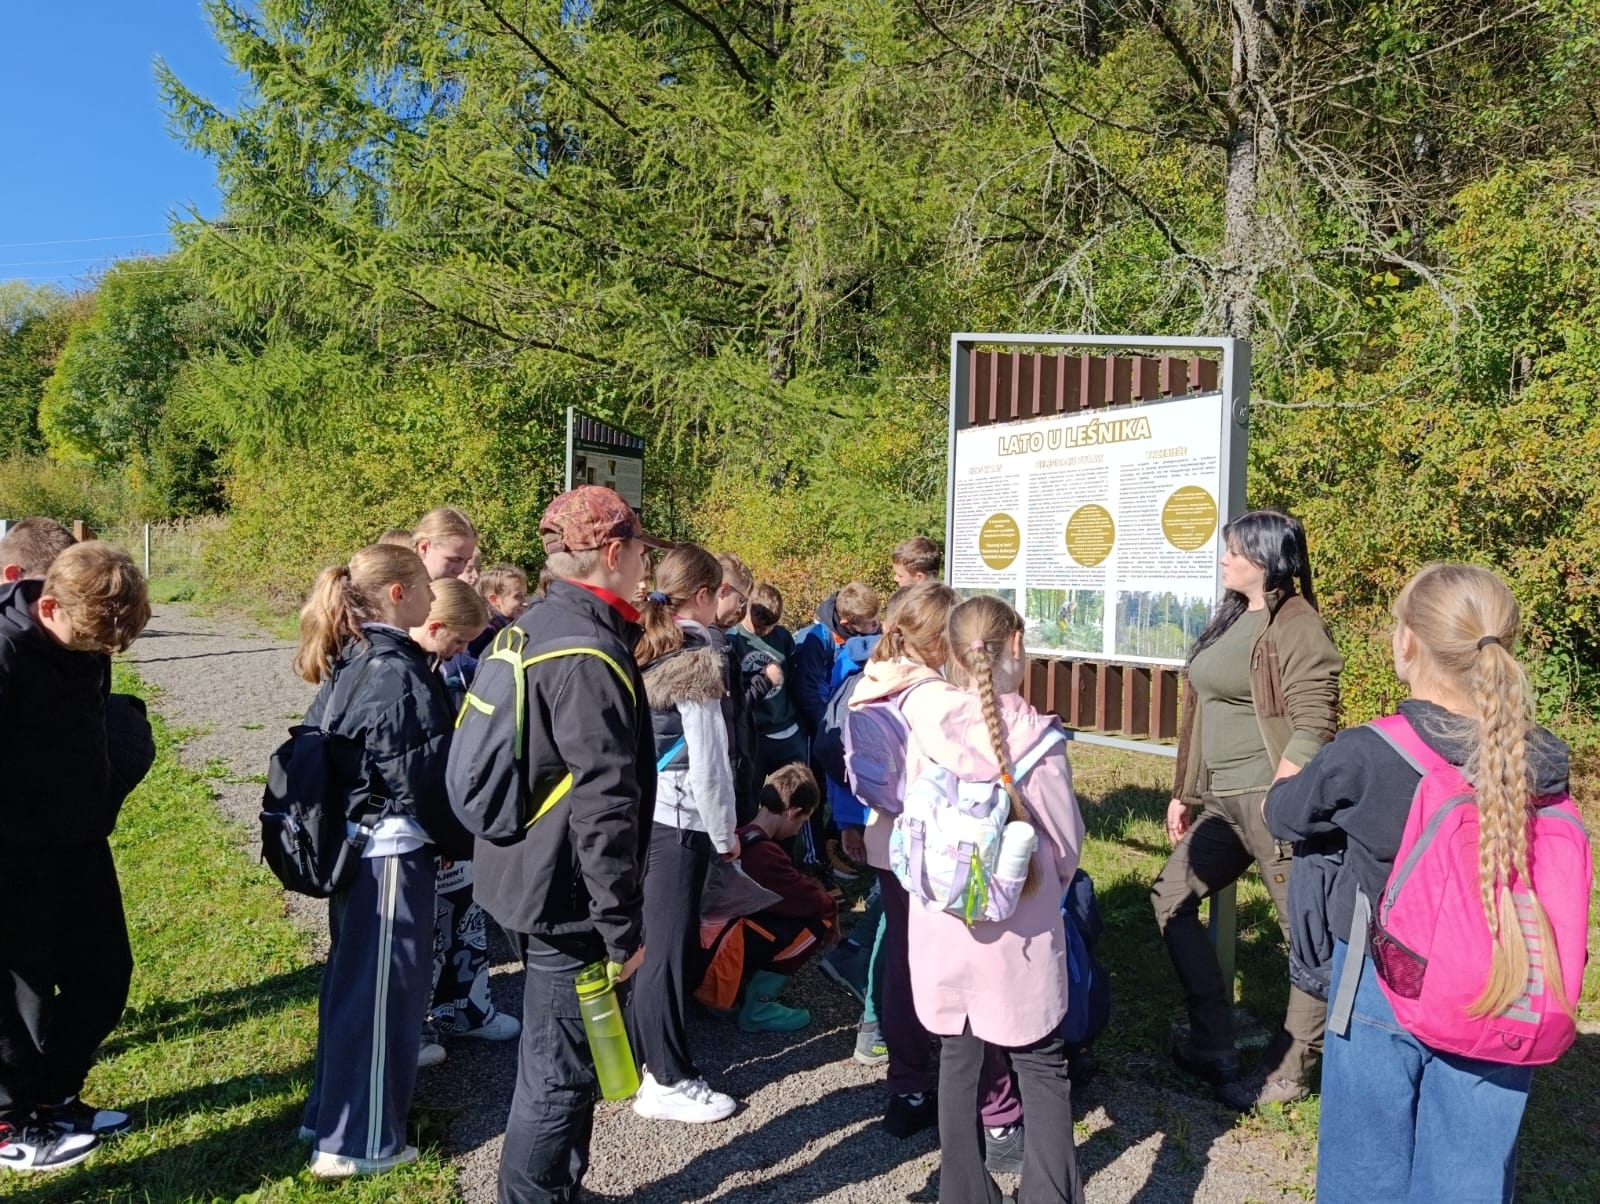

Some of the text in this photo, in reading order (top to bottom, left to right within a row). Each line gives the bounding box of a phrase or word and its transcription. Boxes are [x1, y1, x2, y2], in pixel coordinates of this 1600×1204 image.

[998, 416, 1152, 456] LATO U LEŚNIKA
